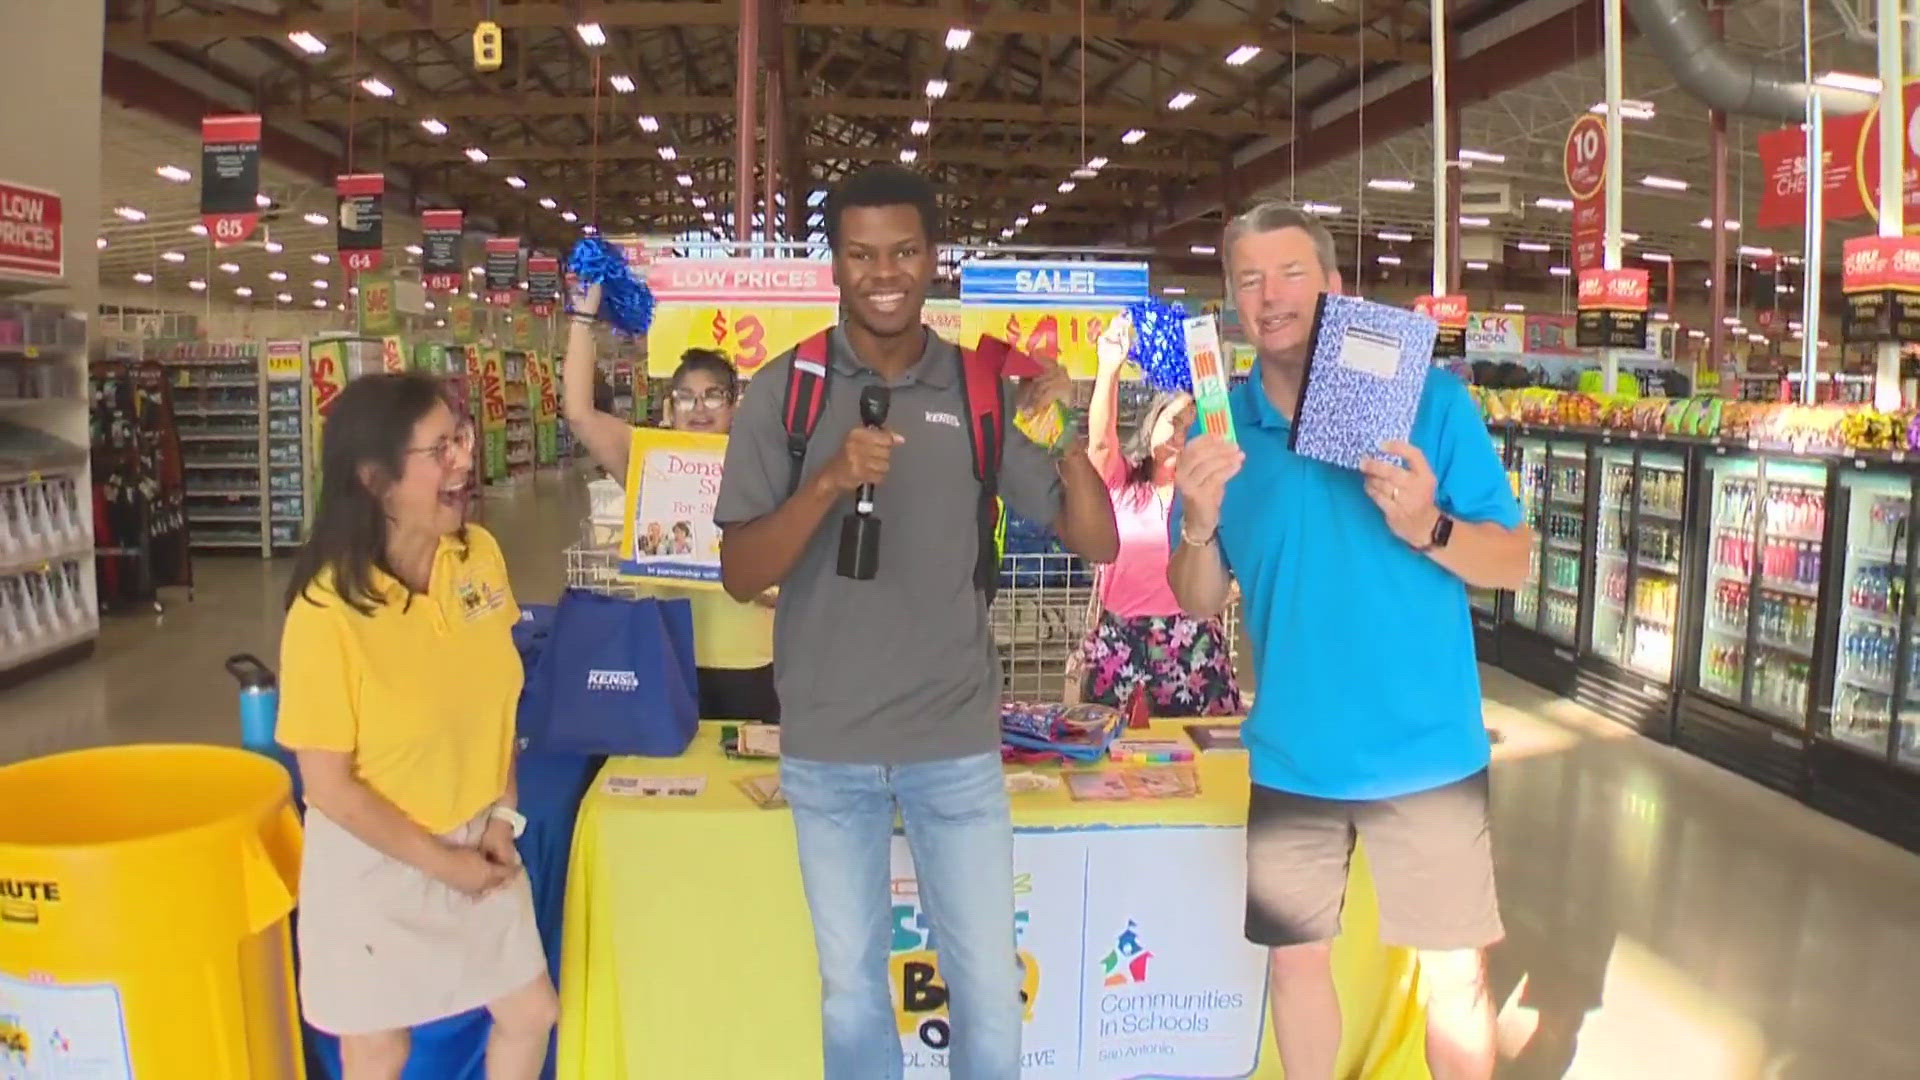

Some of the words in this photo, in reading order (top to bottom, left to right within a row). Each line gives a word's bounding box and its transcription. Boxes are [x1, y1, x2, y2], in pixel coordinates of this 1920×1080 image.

[1573, 128, 1599, 164] 10
[2, 191, 44, 223] LOW
[215, 219, 243, 237] 65
[349, 254, 371, 269] 64
[672, 270, 726, 287] LOW
[733, 270, 818, 287] PRICES
[1015, 270, 1095, 294] SALE!
[483, 359, 506, 422] SAVE
[673, 501, 695, 514] For
[1101, 989, 1243, 1014] Communities
[1100, 1017, 1117, 1037] In
[1122, 1012, 1209, 1034] Schools
